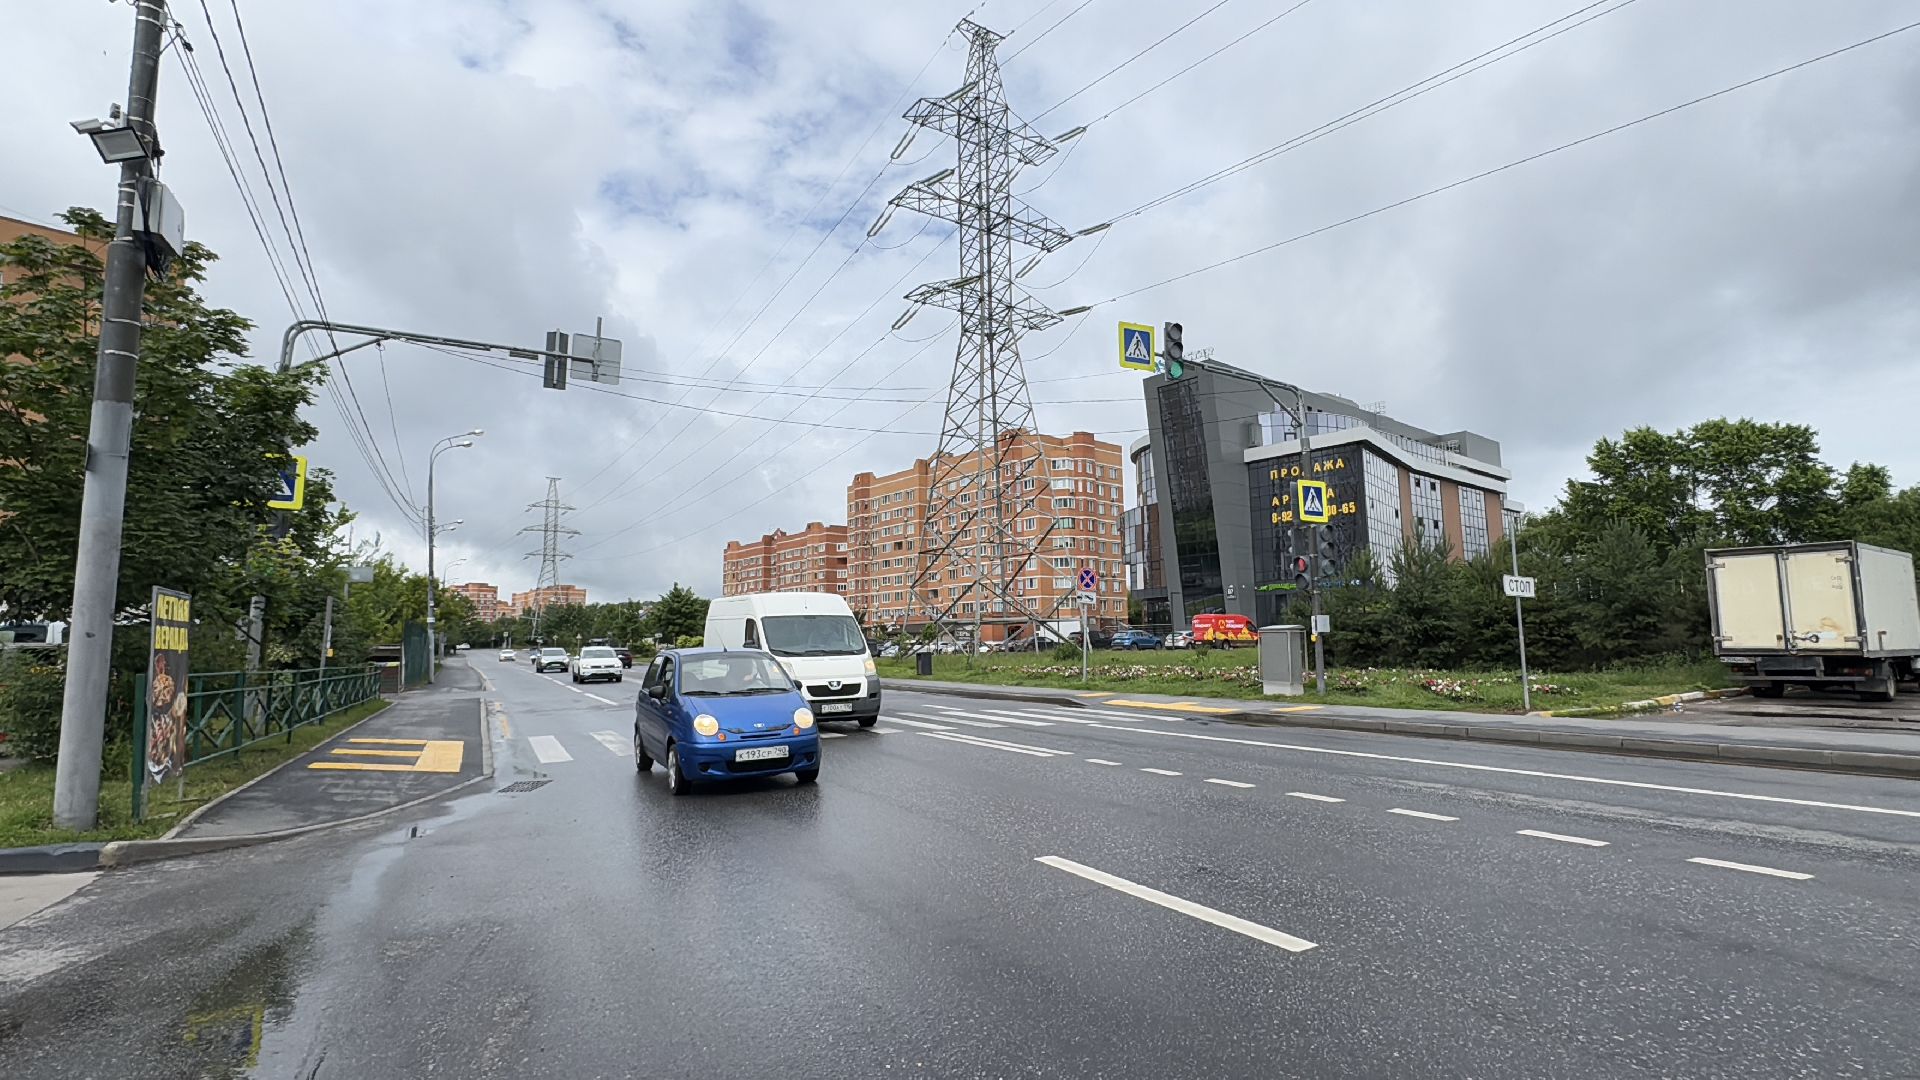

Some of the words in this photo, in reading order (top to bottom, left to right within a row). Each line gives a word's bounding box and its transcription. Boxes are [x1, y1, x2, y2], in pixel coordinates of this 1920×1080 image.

[1270, 458, 1345, 480] ПРОАЖА
[1271, 487, 1335, 507] АРА
[1508, 578, 1531, 594] СТОП
